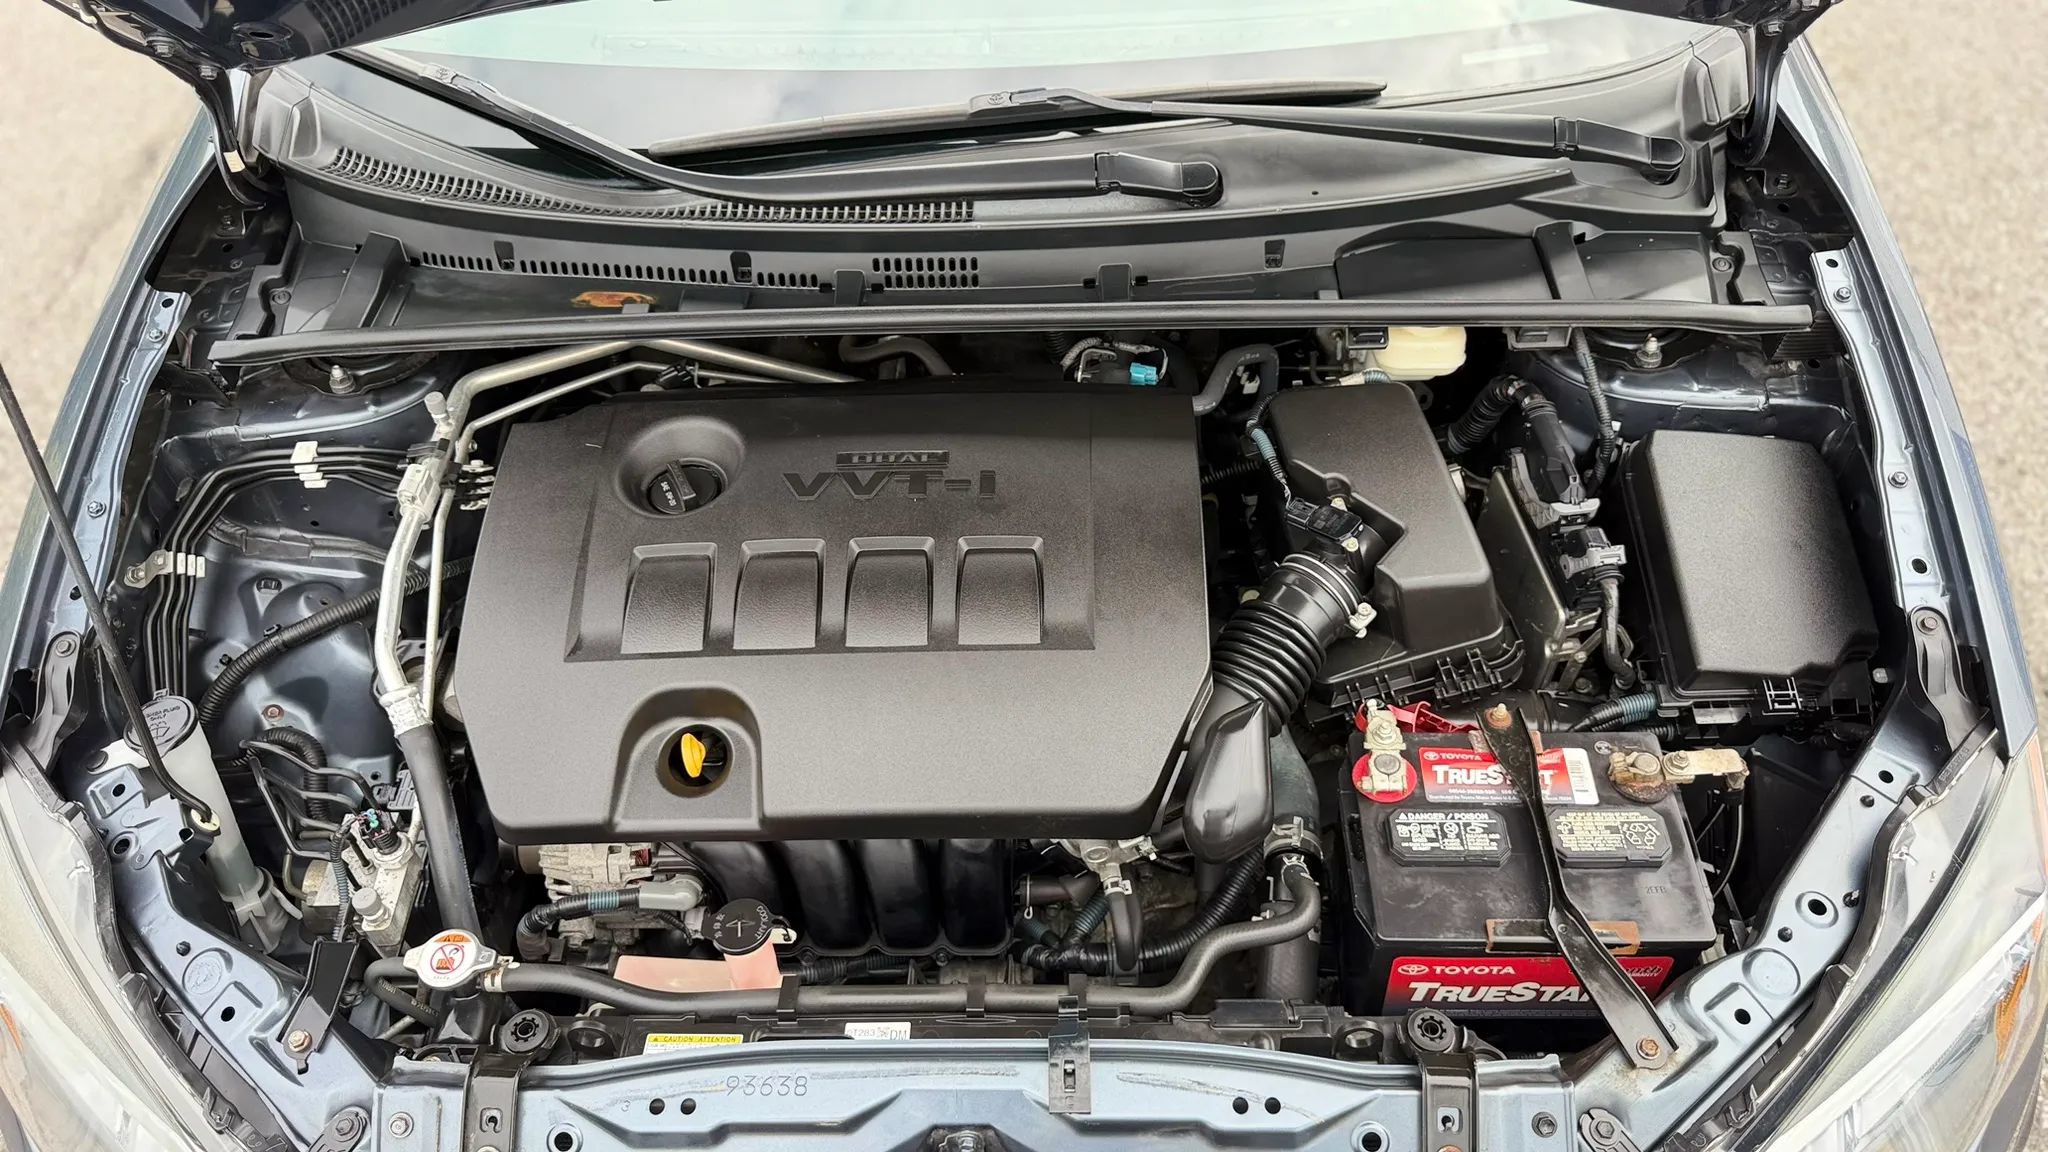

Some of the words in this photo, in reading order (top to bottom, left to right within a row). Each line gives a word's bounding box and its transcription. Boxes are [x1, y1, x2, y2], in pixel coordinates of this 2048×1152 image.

[1439, 752, 1482, 761] TOYOTA
[1407, 812, 1446, 820] DANGER
[1454, 812, 1489, 820] POISON
[1433, 965, 1516, 975] TOYOTA
[726, 1075, 808, 1097] 93638
